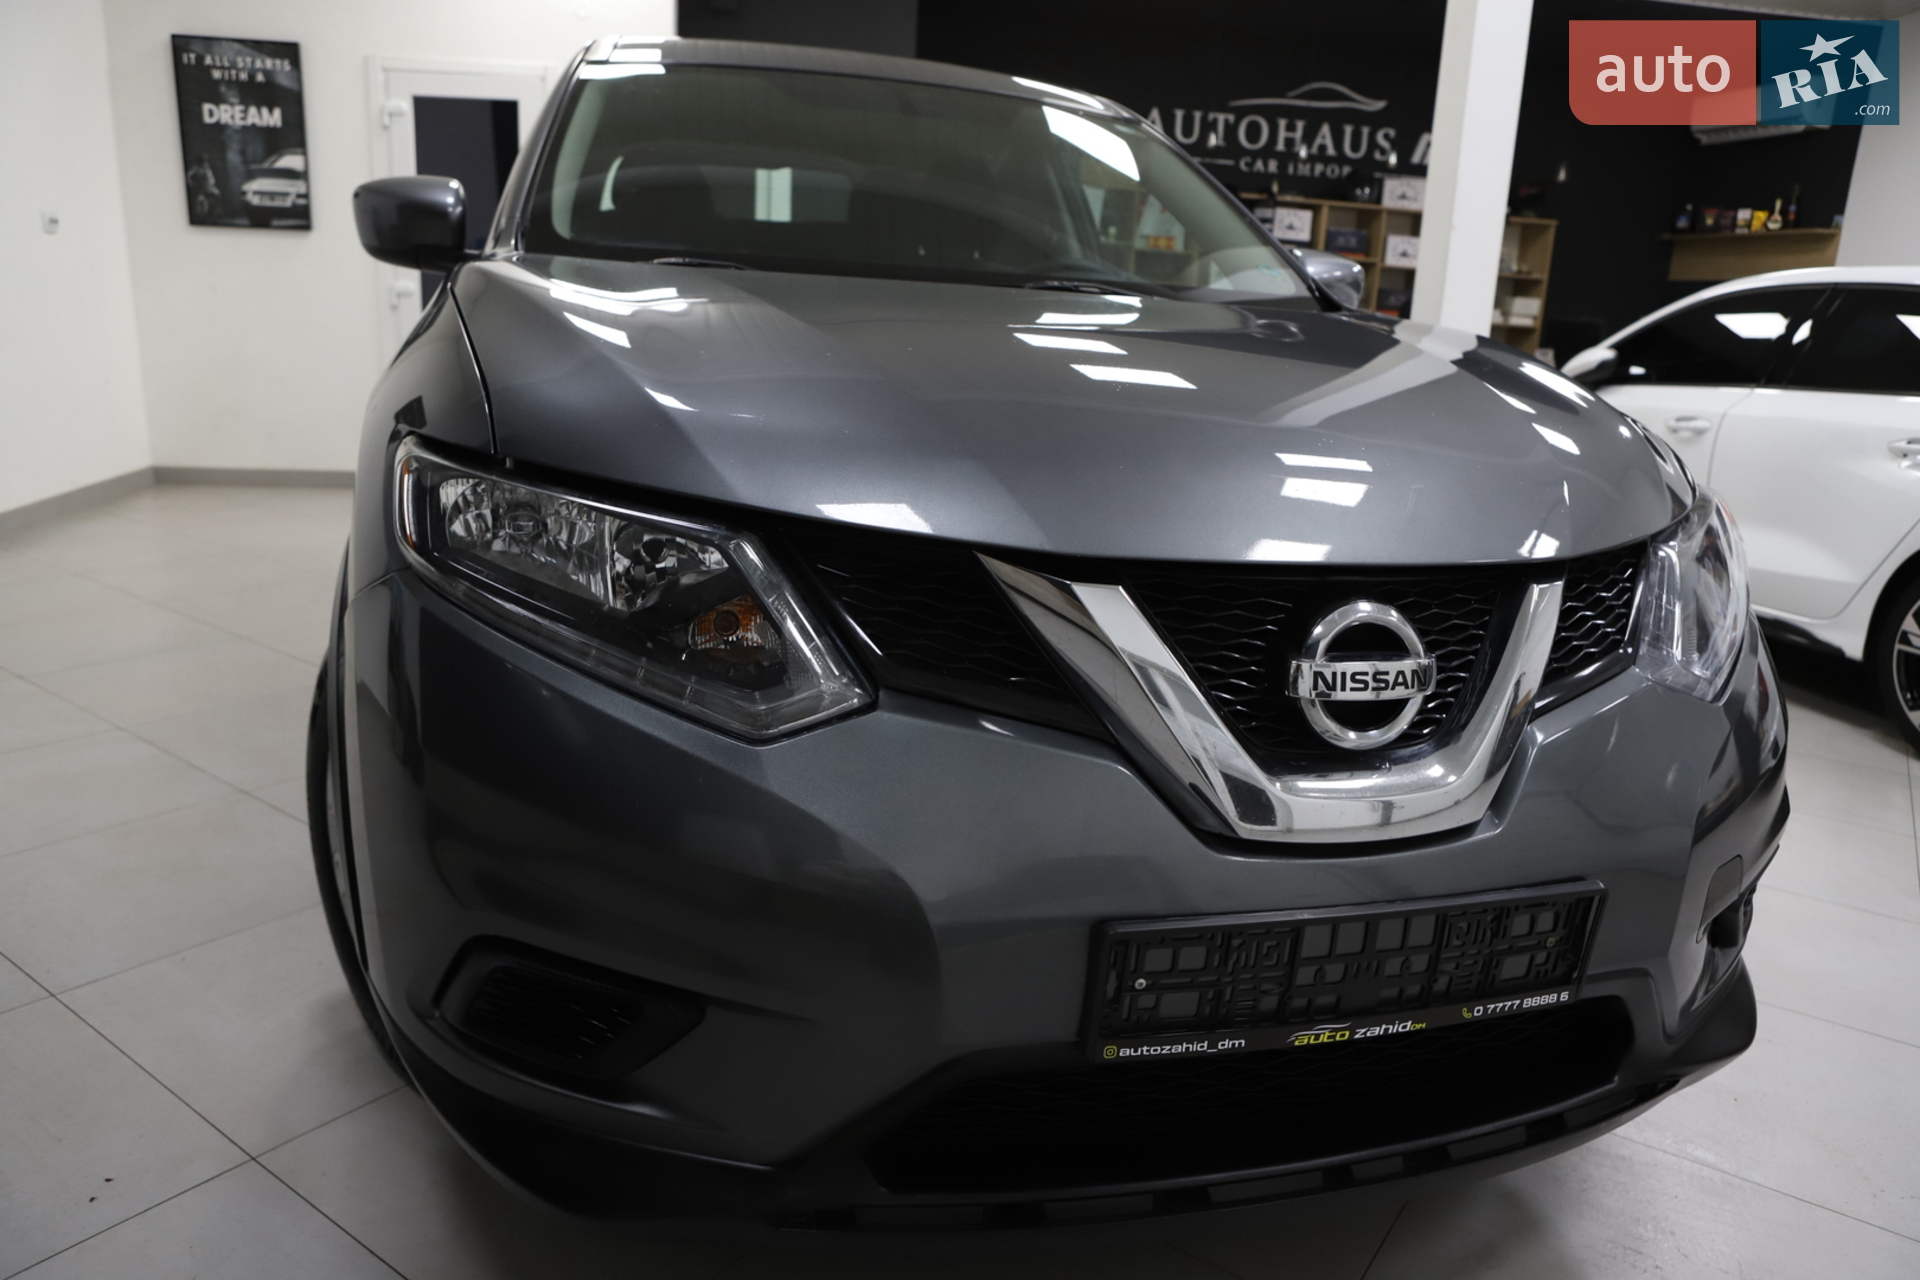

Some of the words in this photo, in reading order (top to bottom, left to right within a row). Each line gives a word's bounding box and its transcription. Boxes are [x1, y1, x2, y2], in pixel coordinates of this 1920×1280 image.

[182, 52, 197, 65] IT
[203, 54, 231, 68] ALL
[236, 56, 292, 72] STARTS
[211, 68, 249, 82] WITH
[254, 71, 266, 83] A
[201, 102, 283, 128] DREAM
[1147, 106, 1397, 161] AUTOHAUS
[1238, 155, 1280, 175] CAR
[1287, 159, 1353, 178] IMPOR
[1312, 669, 1428, 692] NISSAN
[1486, 999, 1521, 1014] 7777
[1522, 993, 1558, 1008] 8888
[1119, 1038, 1246, 1057] autozahid_dm
[1294, 1029, 1350, 1046] auto
